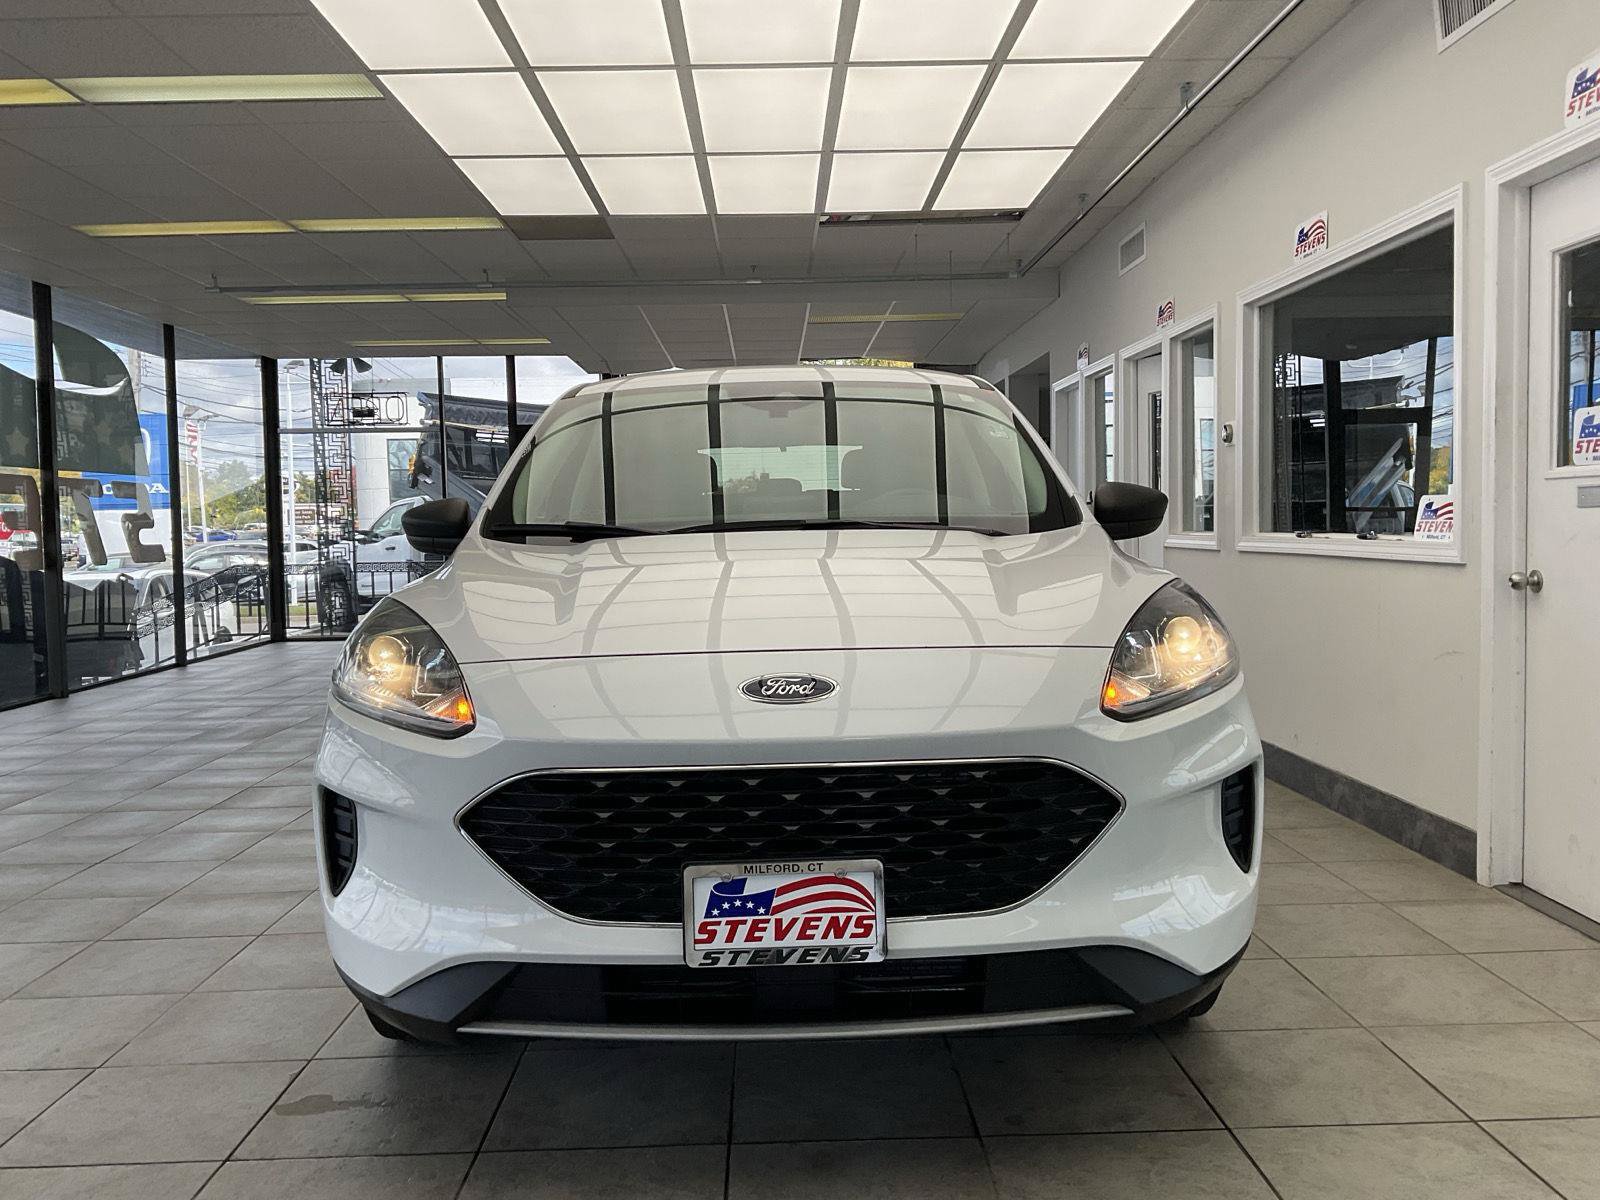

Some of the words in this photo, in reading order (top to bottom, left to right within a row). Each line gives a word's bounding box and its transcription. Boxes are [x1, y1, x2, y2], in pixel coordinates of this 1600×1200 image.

[1294, 232, 1326, 258] STEVENS
[761, 678, 817, 696] Ford
[743, 863, 804, 875] MILFORD,
[807, 862, 824, 873] CT
[694, 914, 877, 945] STEVENS
[698, 946, 874, 967] STEVENS
